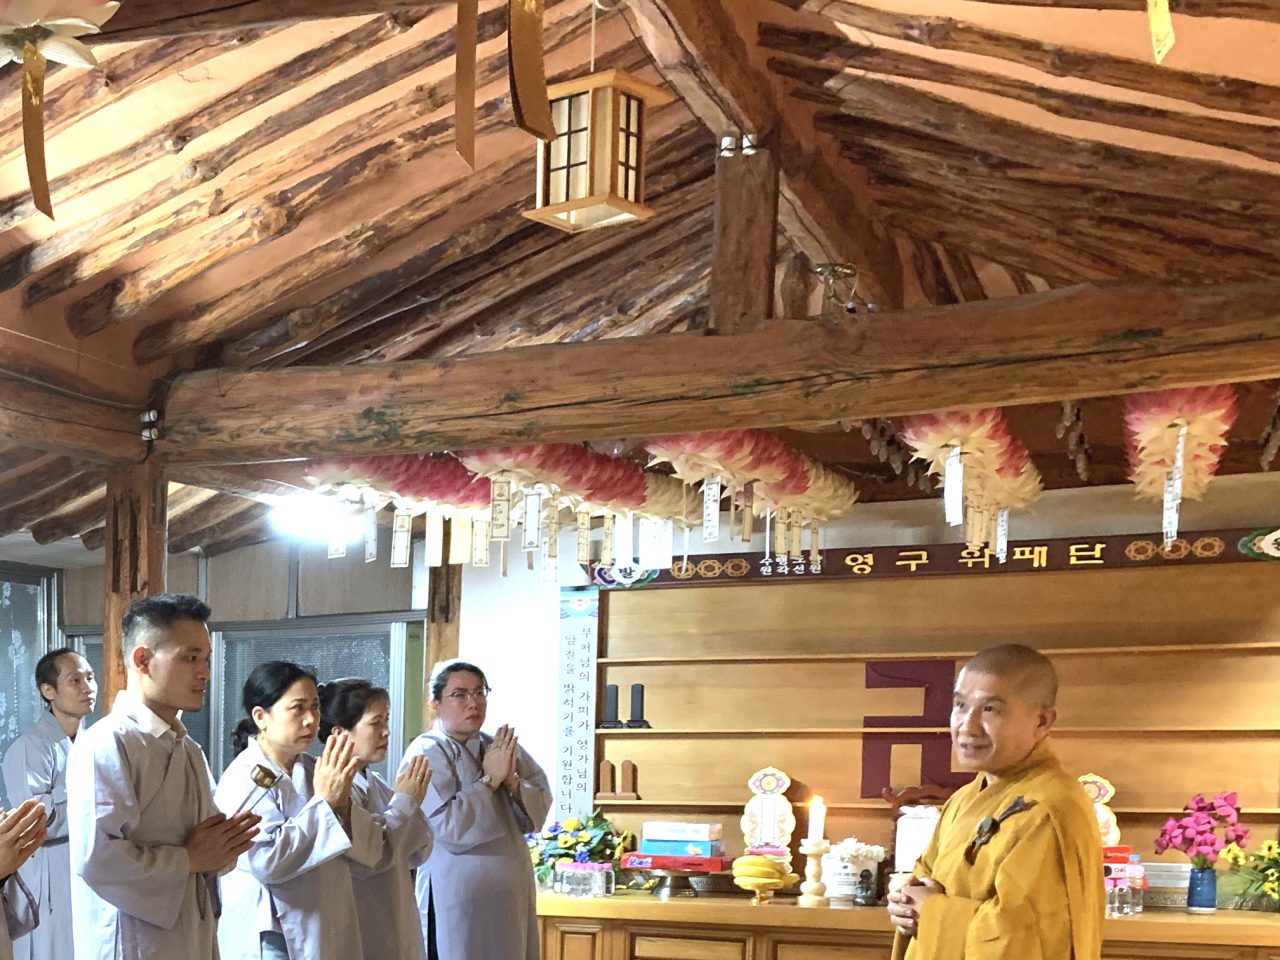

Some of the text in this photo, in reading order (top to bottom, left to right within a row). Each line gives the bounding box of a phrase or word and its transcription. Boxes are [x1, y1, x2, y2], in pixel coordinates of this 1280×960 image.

[576, 627, 592, 793] 부처님의 가피가 영가님의
[560, 745, 573, 814] 기원합니다
